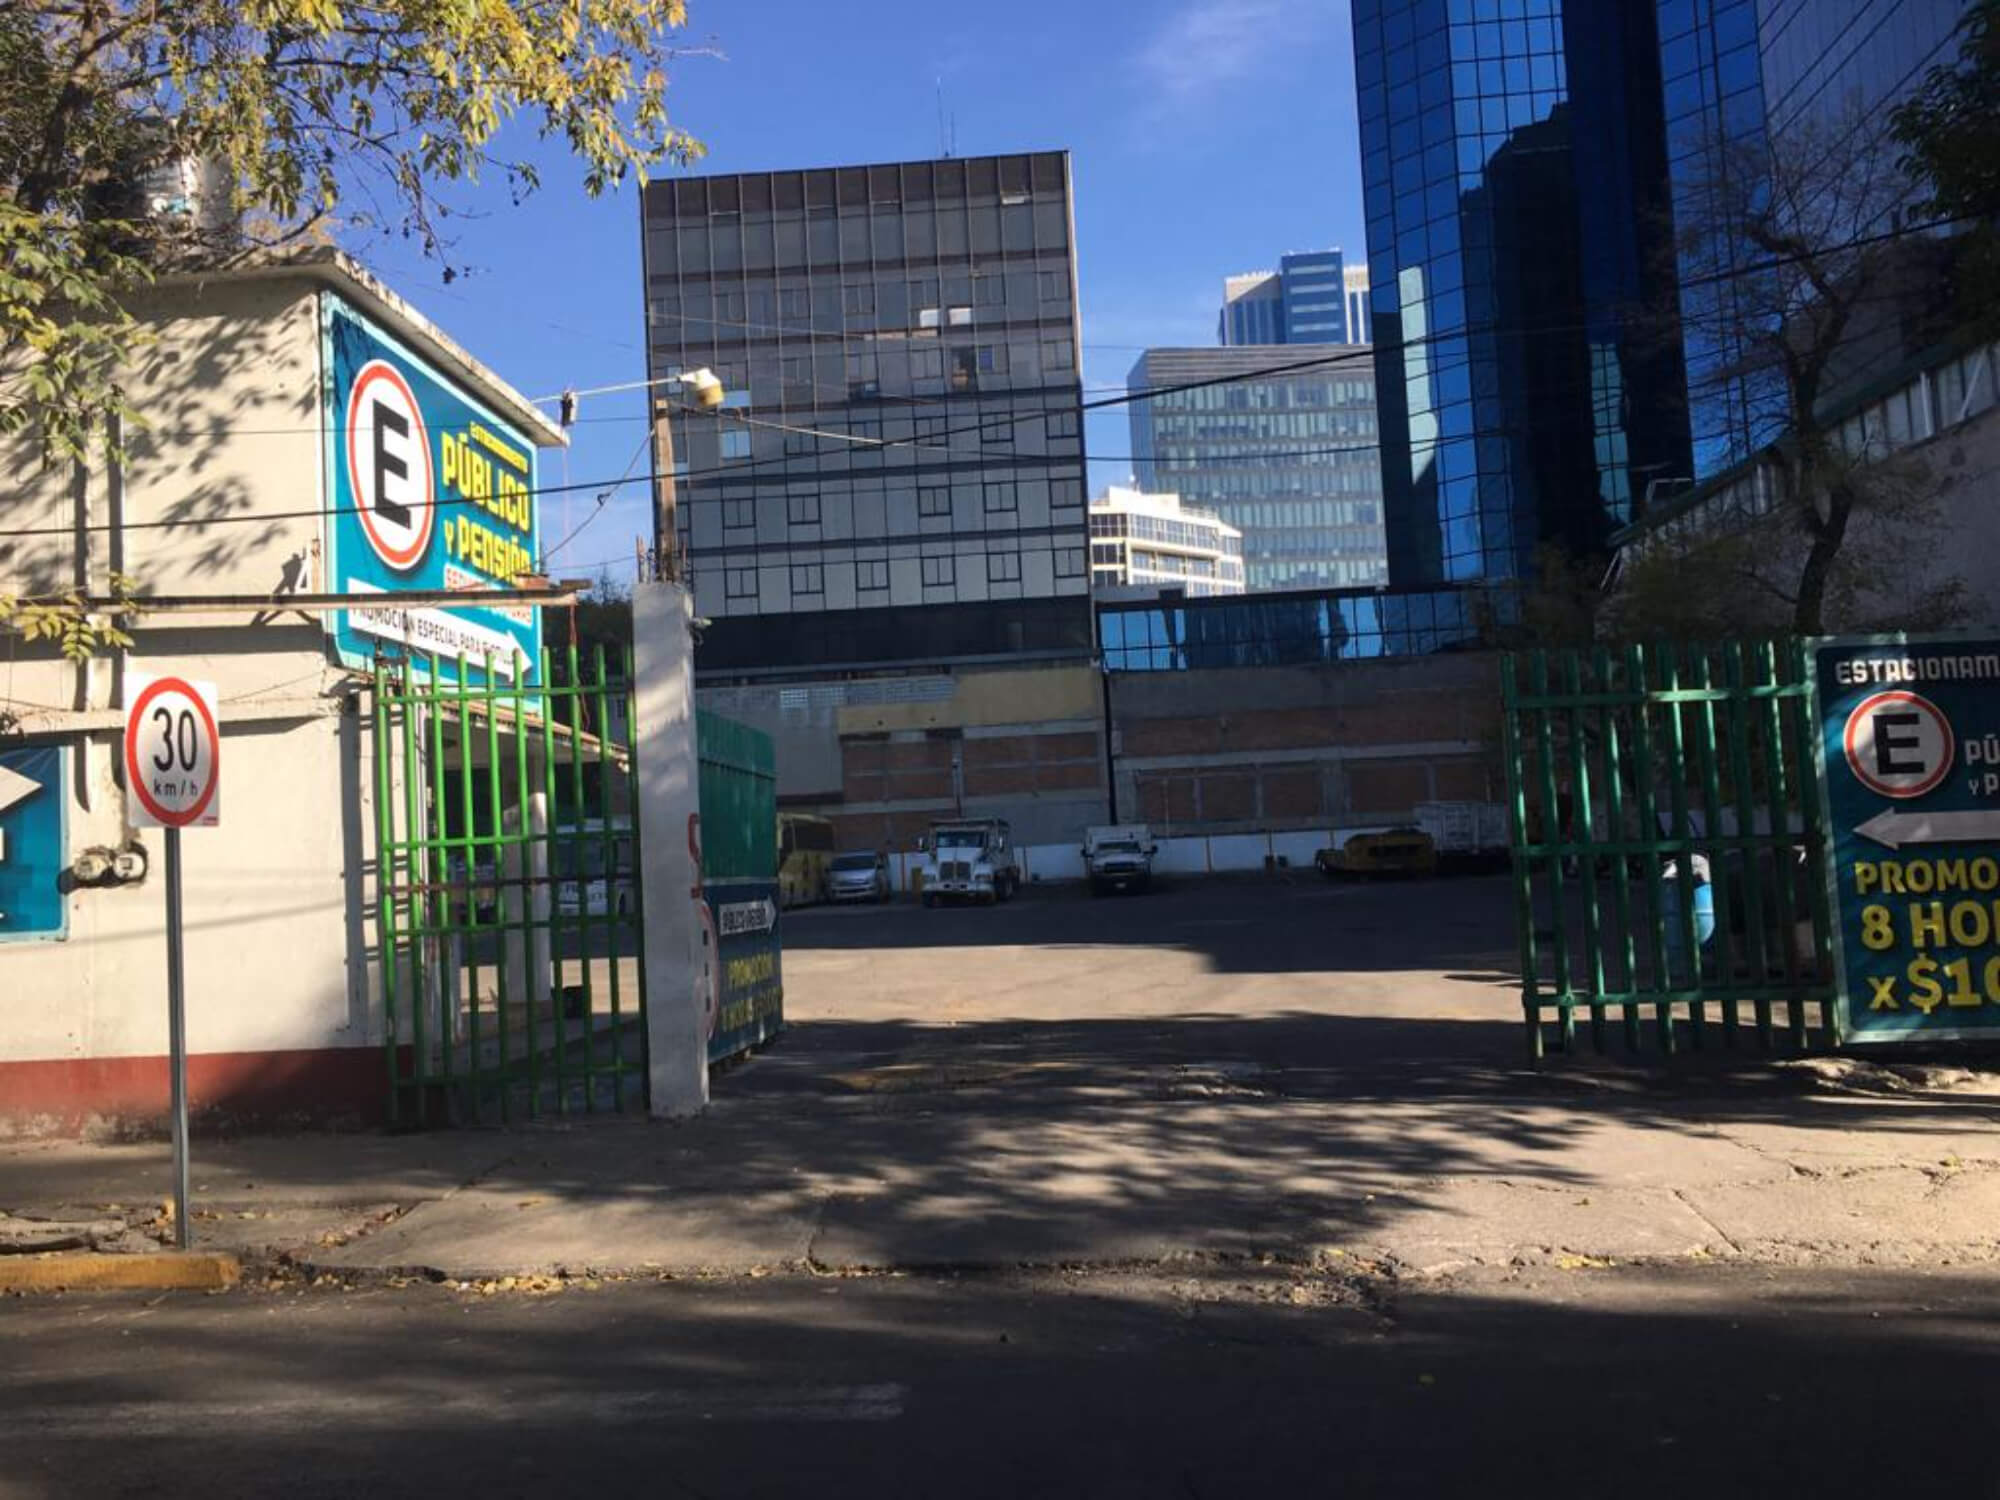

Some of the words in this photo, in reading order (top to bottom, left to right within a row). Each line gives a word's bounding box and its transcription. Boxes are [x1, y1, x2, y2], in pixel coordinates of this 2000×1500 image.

[373, 398, 411, 530] E
[442, 431, 530, 532] PÚBLICO
[153, 707, 197, 772] 30
[1872, 712, 1926, 775] E
[153, 778, 198, 796] km/h
[1854, 856, 1999, 895] PROMO
[1862, 904, 1894, 951] 8
